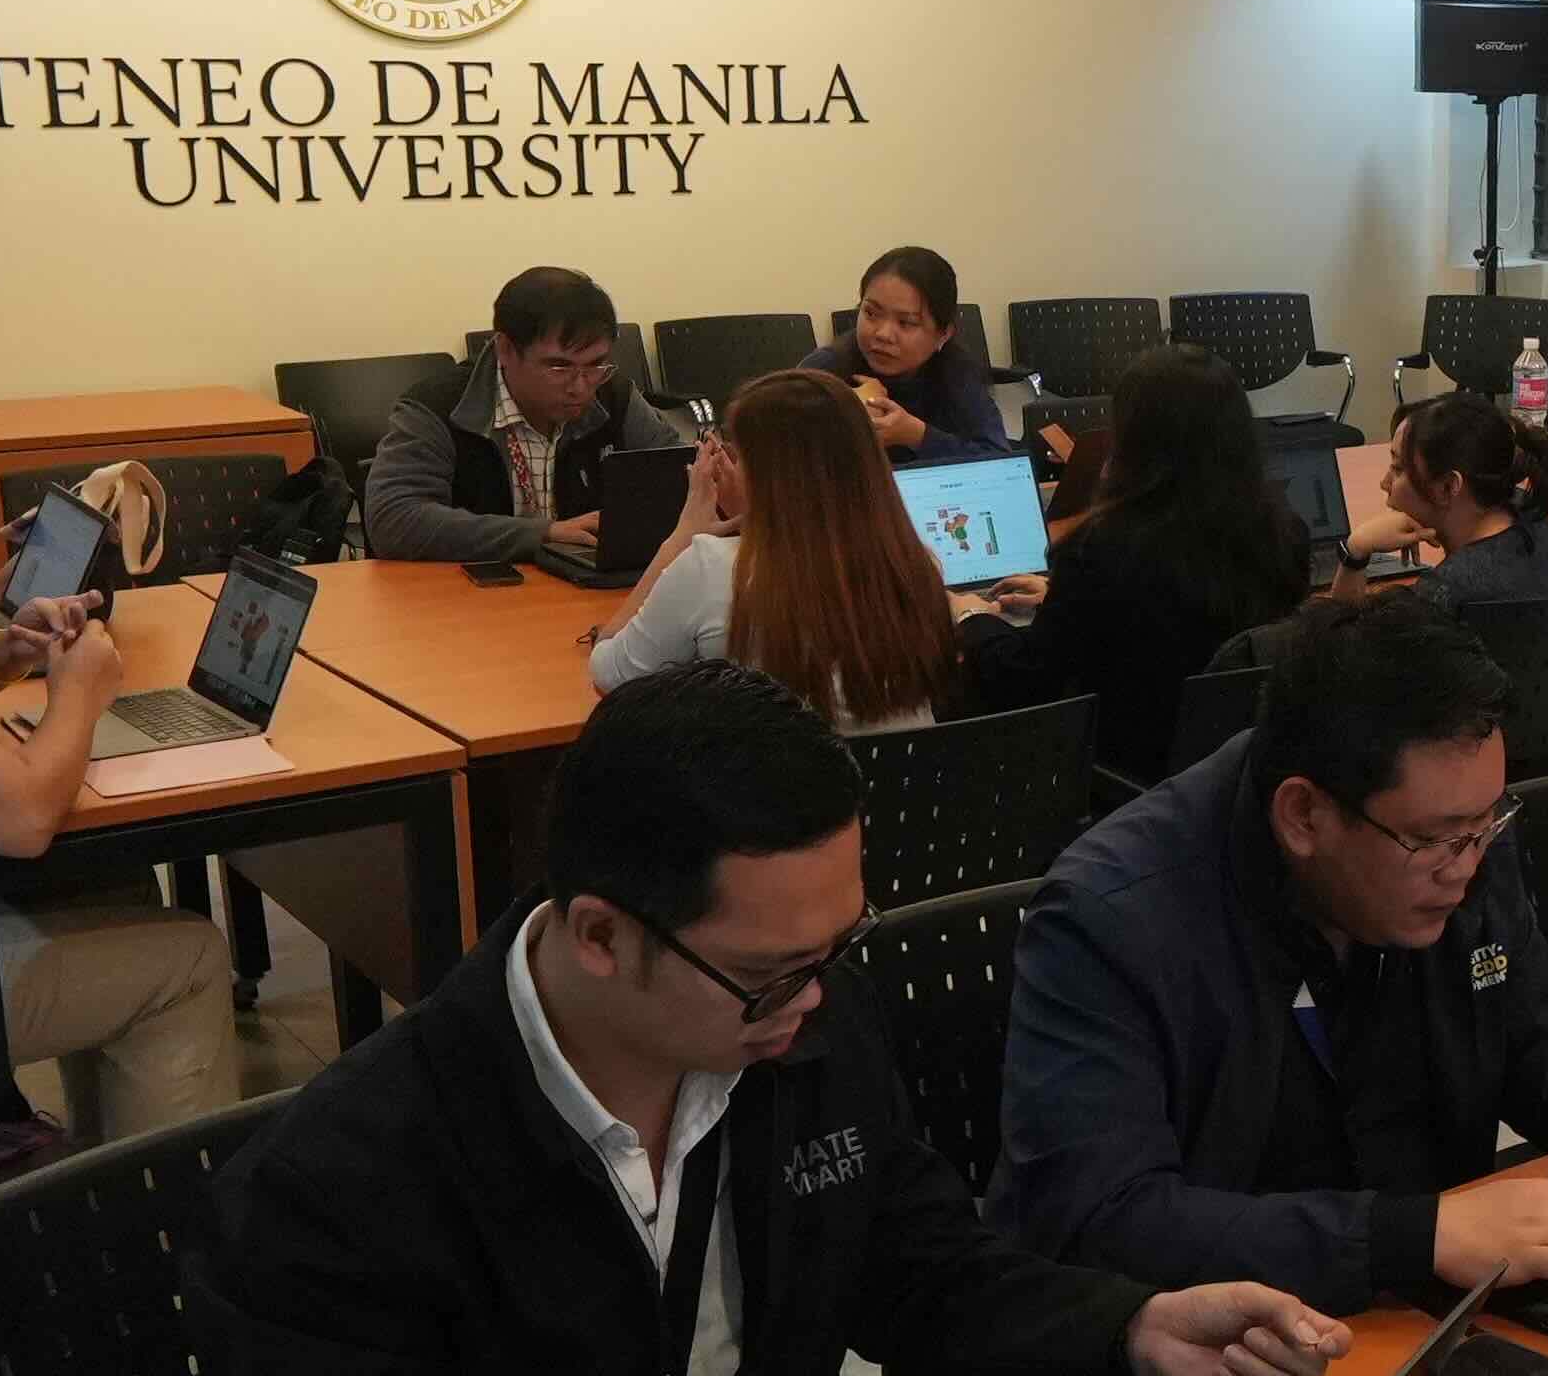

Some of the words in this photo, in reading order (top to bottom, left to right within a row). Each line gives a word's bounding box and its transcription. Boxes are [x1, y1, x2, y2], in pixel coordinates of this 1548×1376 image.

[407, 9, 451, 31] DE
[368, 59, 501, 127] DE
[528, 61, 871, 127] MANILA
[122, 131, 706, 209] UNIVERSITY
